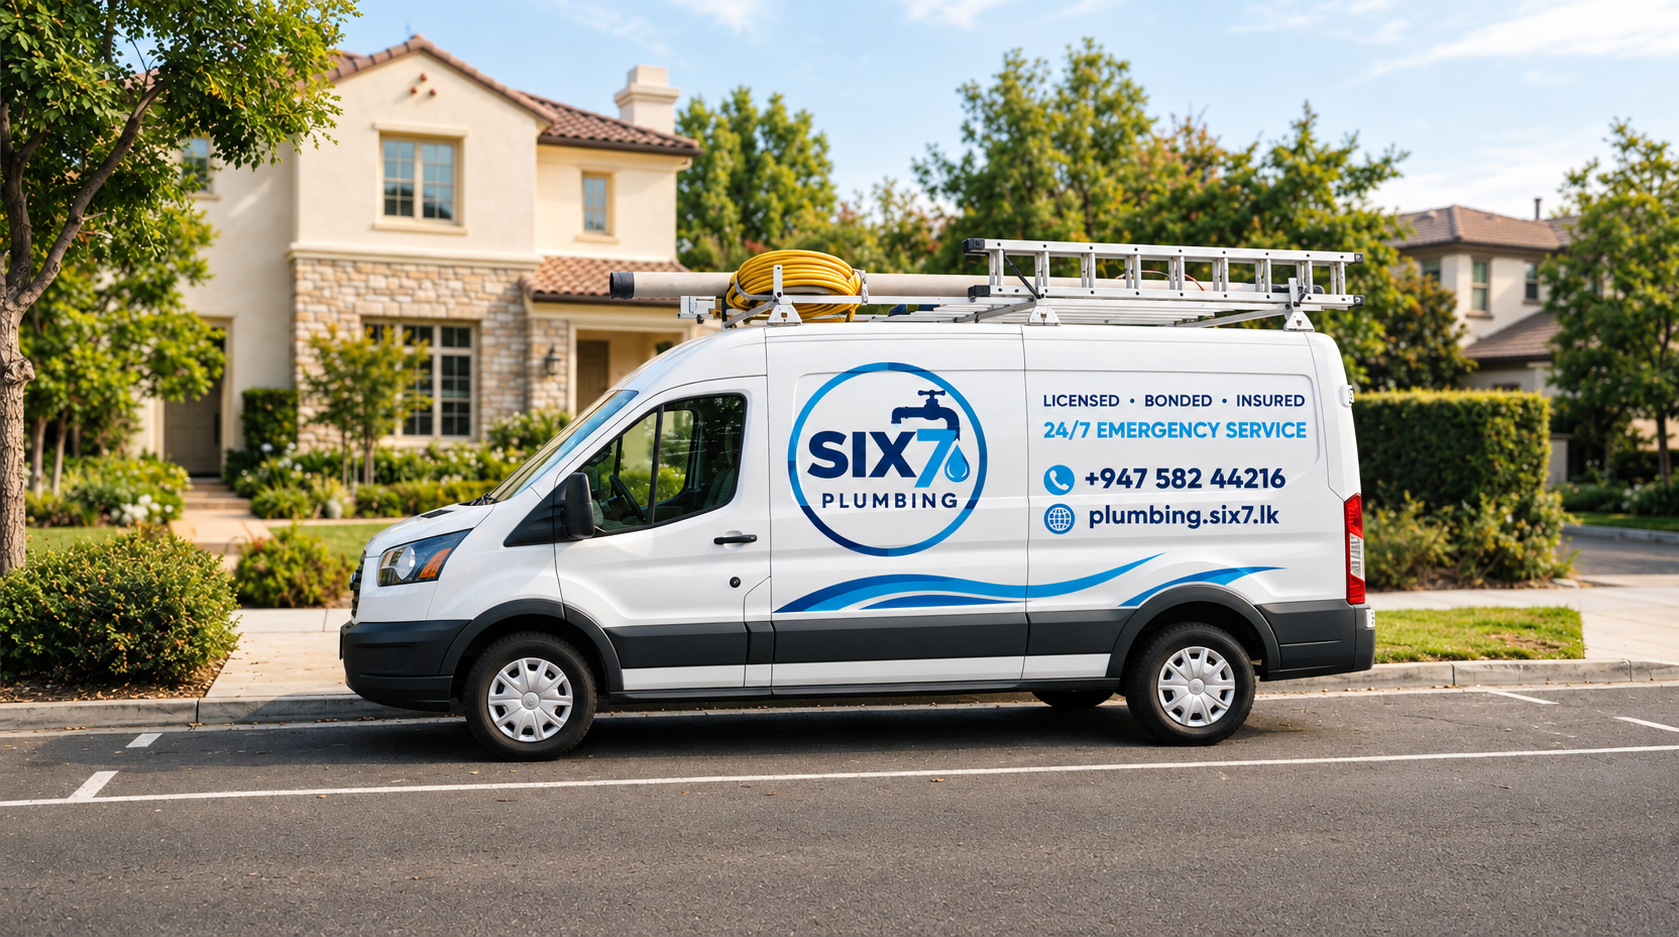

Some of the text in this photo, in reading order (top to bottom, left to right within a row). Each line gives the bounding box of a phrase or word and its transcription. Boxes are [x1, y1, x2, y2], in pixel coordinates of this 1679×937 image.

[1043, 394, 1306, 407] LICENSED BONDED INSURED
[1043, 420, 1307, 440] 24/7 EMERGENCY SERVICE
[1085, 468, 1286, 489] +947 582 44216
[822, 492, 958, 509] PLUMBING
[1089, 505, 1279, 529] plumbing.six7.lk
